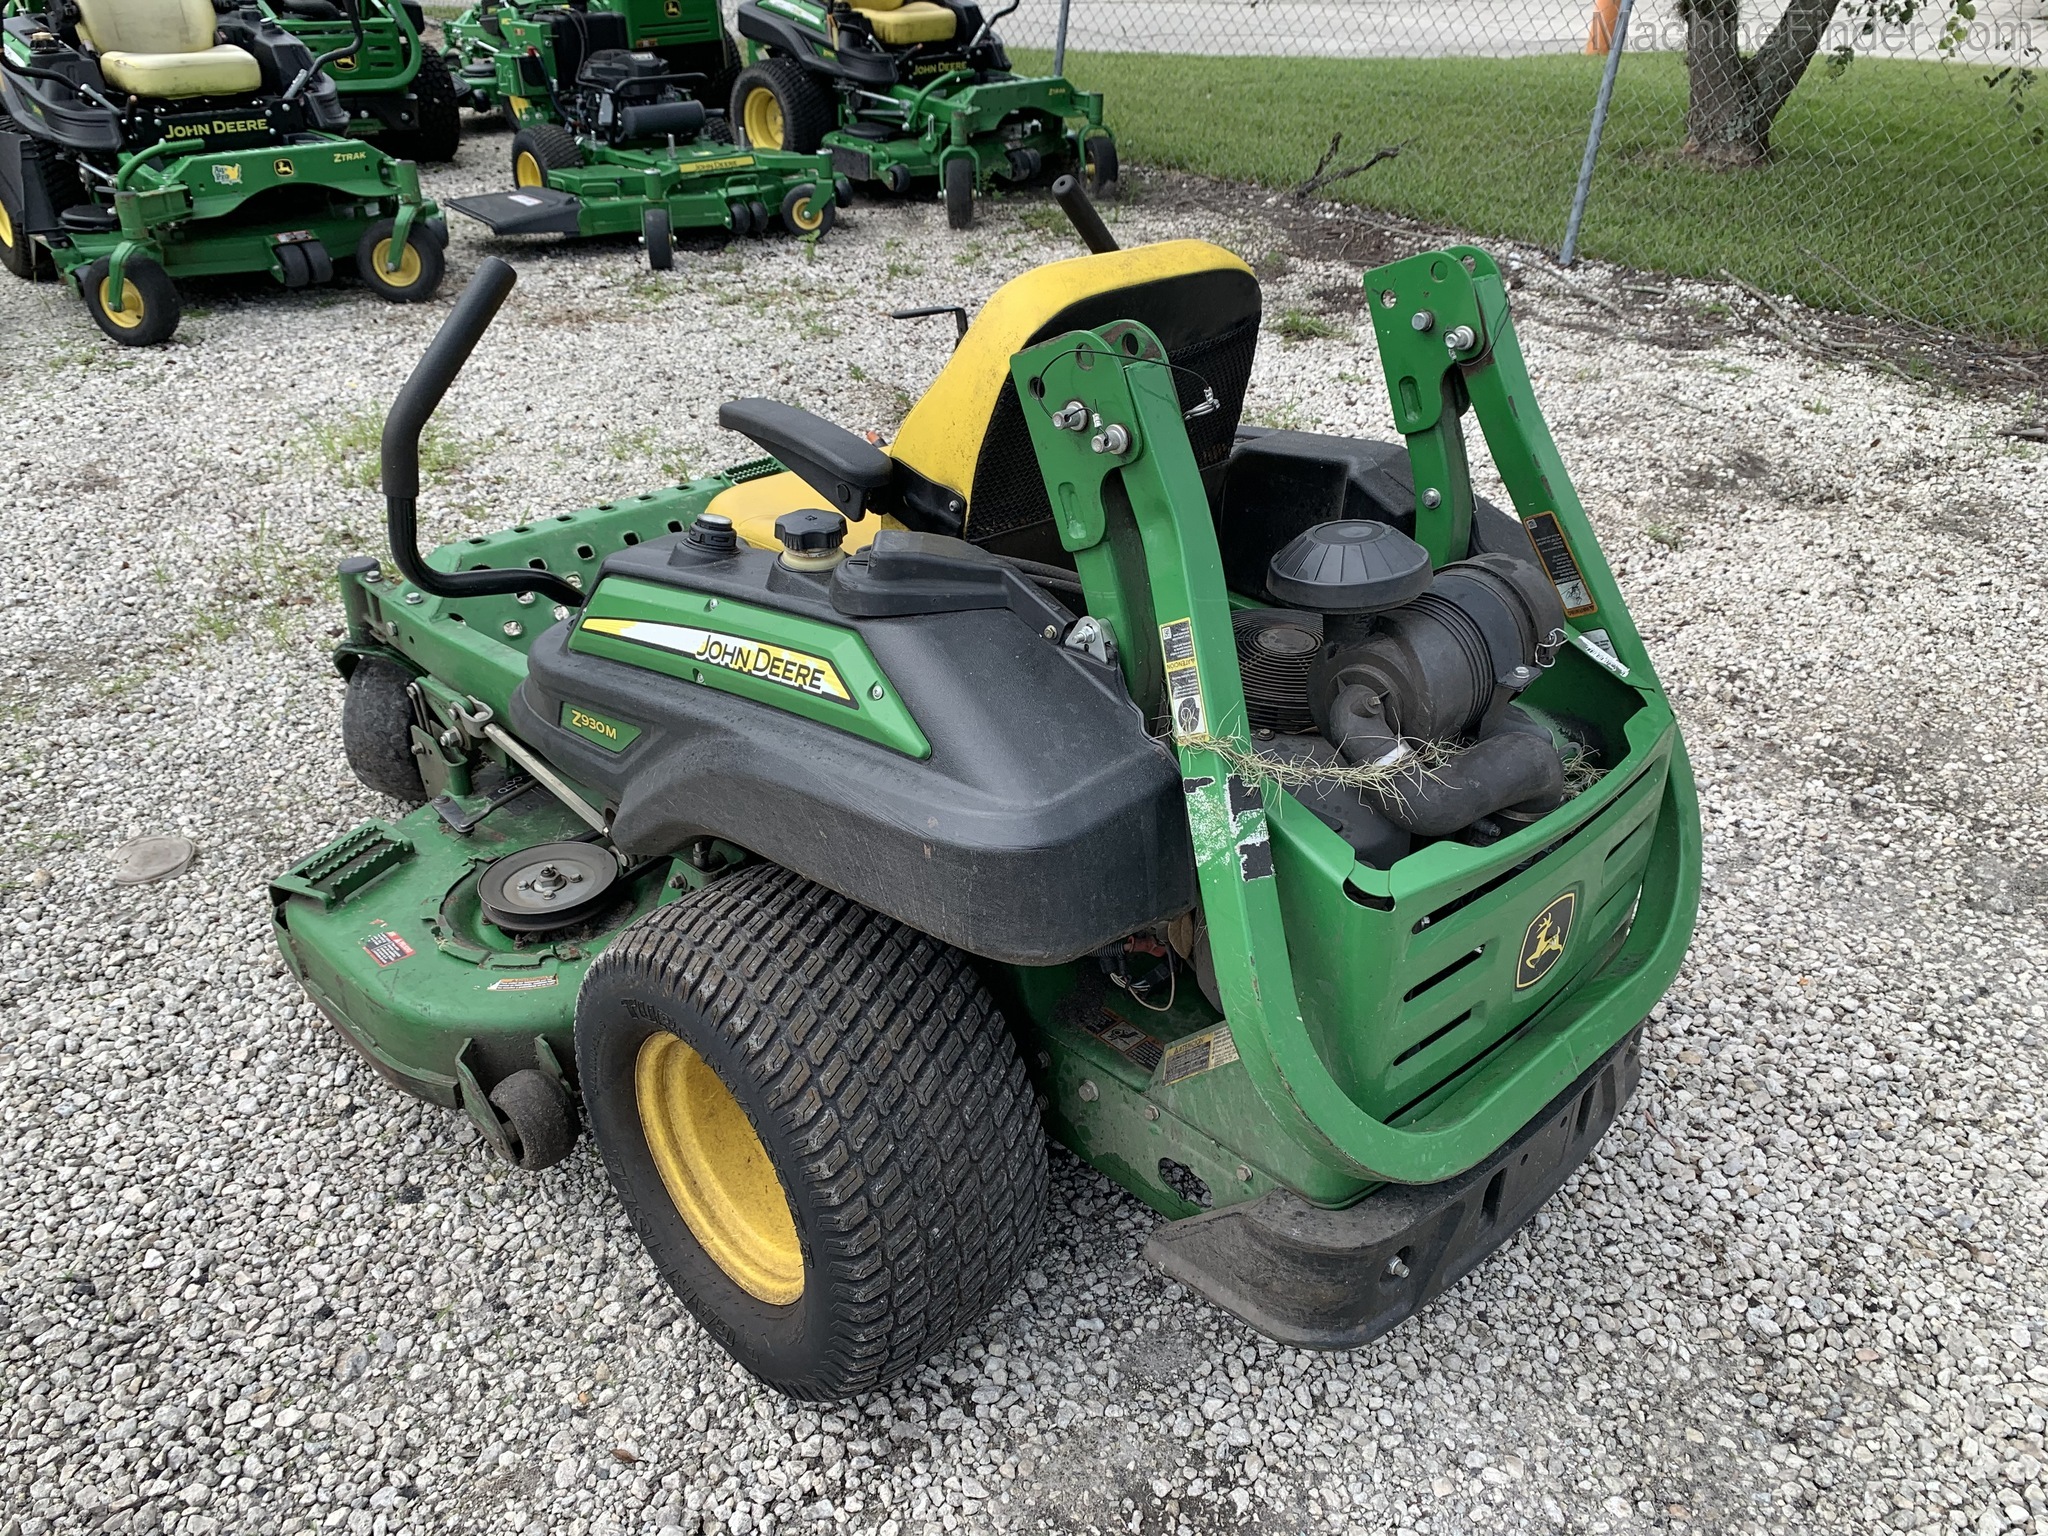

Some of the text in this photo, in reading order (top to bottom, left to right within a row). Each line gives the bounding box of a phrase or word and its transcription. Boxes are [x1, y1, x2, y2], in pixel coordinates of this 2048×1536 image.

[165, 118, 269, 138] JOHN DEERE
[333, 152, 366, 163] ZTRAK
[694, 634, 826, 690] JOHN DEERE
[571, 710, 617, 741] Z930M
